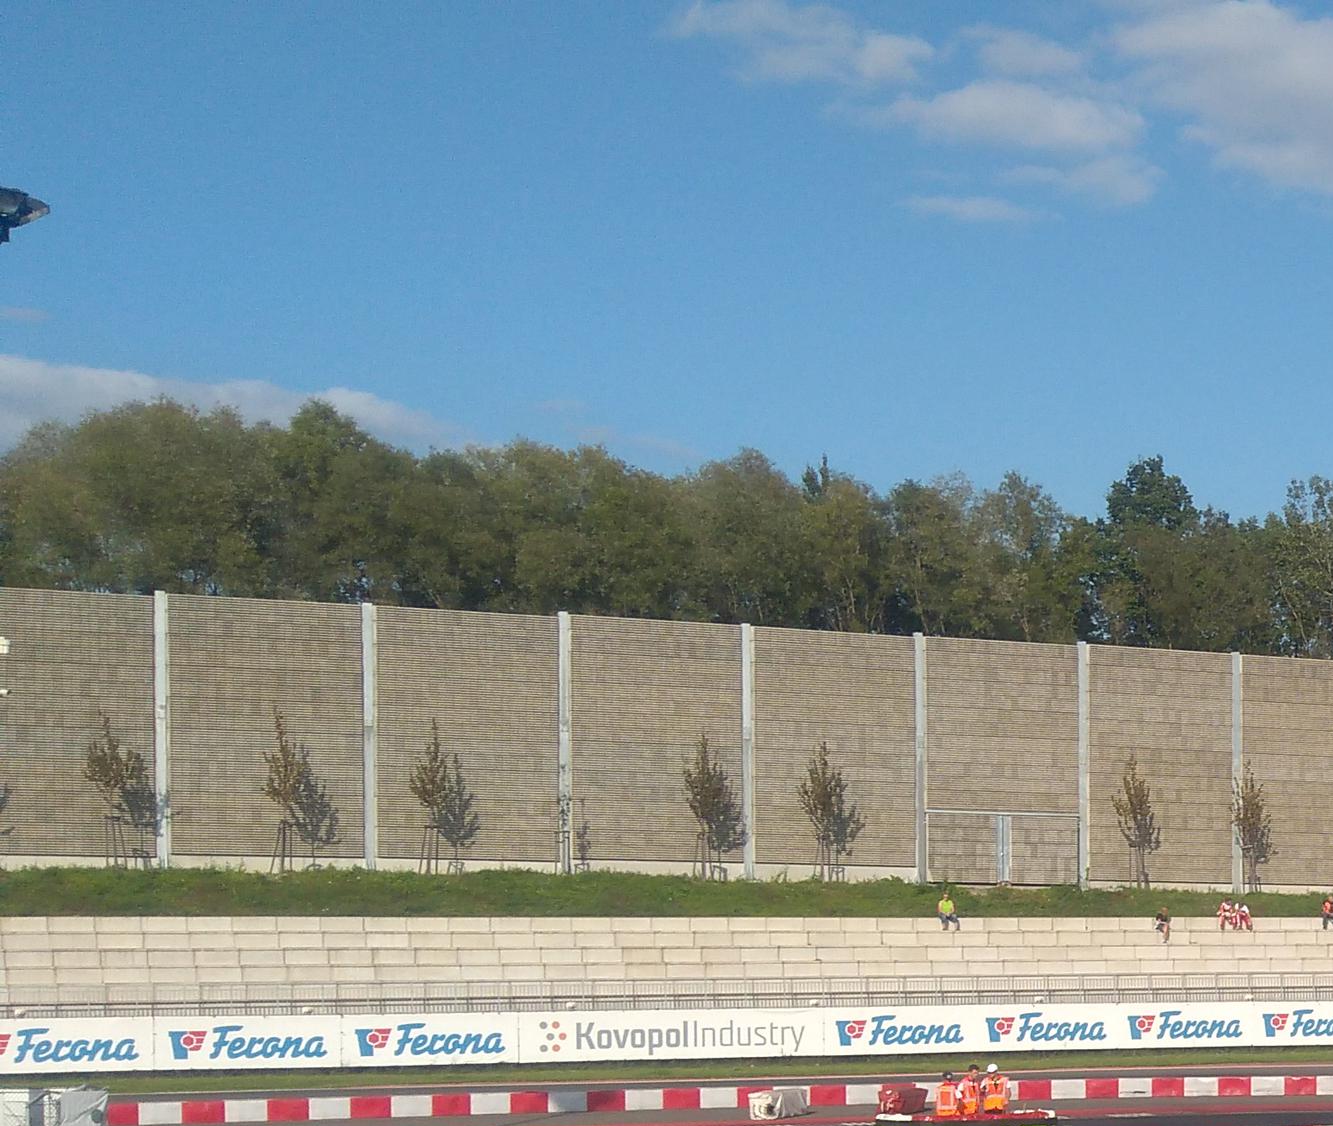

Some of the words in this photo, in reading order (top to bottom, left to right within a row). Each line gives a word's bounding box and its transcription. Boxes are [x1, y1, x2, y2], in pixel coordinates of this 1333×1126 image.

[394, 1023, 506, 1057] Ferona
[869, 1014, 964, 1046] Ferona
[1017, 1012, 1107, 1041] Ferona
[1156, 1011, 1242, 1039] Ferona
[14, 1028, 139, 1062] Ferona
[210, 1025, 327, 1059] Ferona
